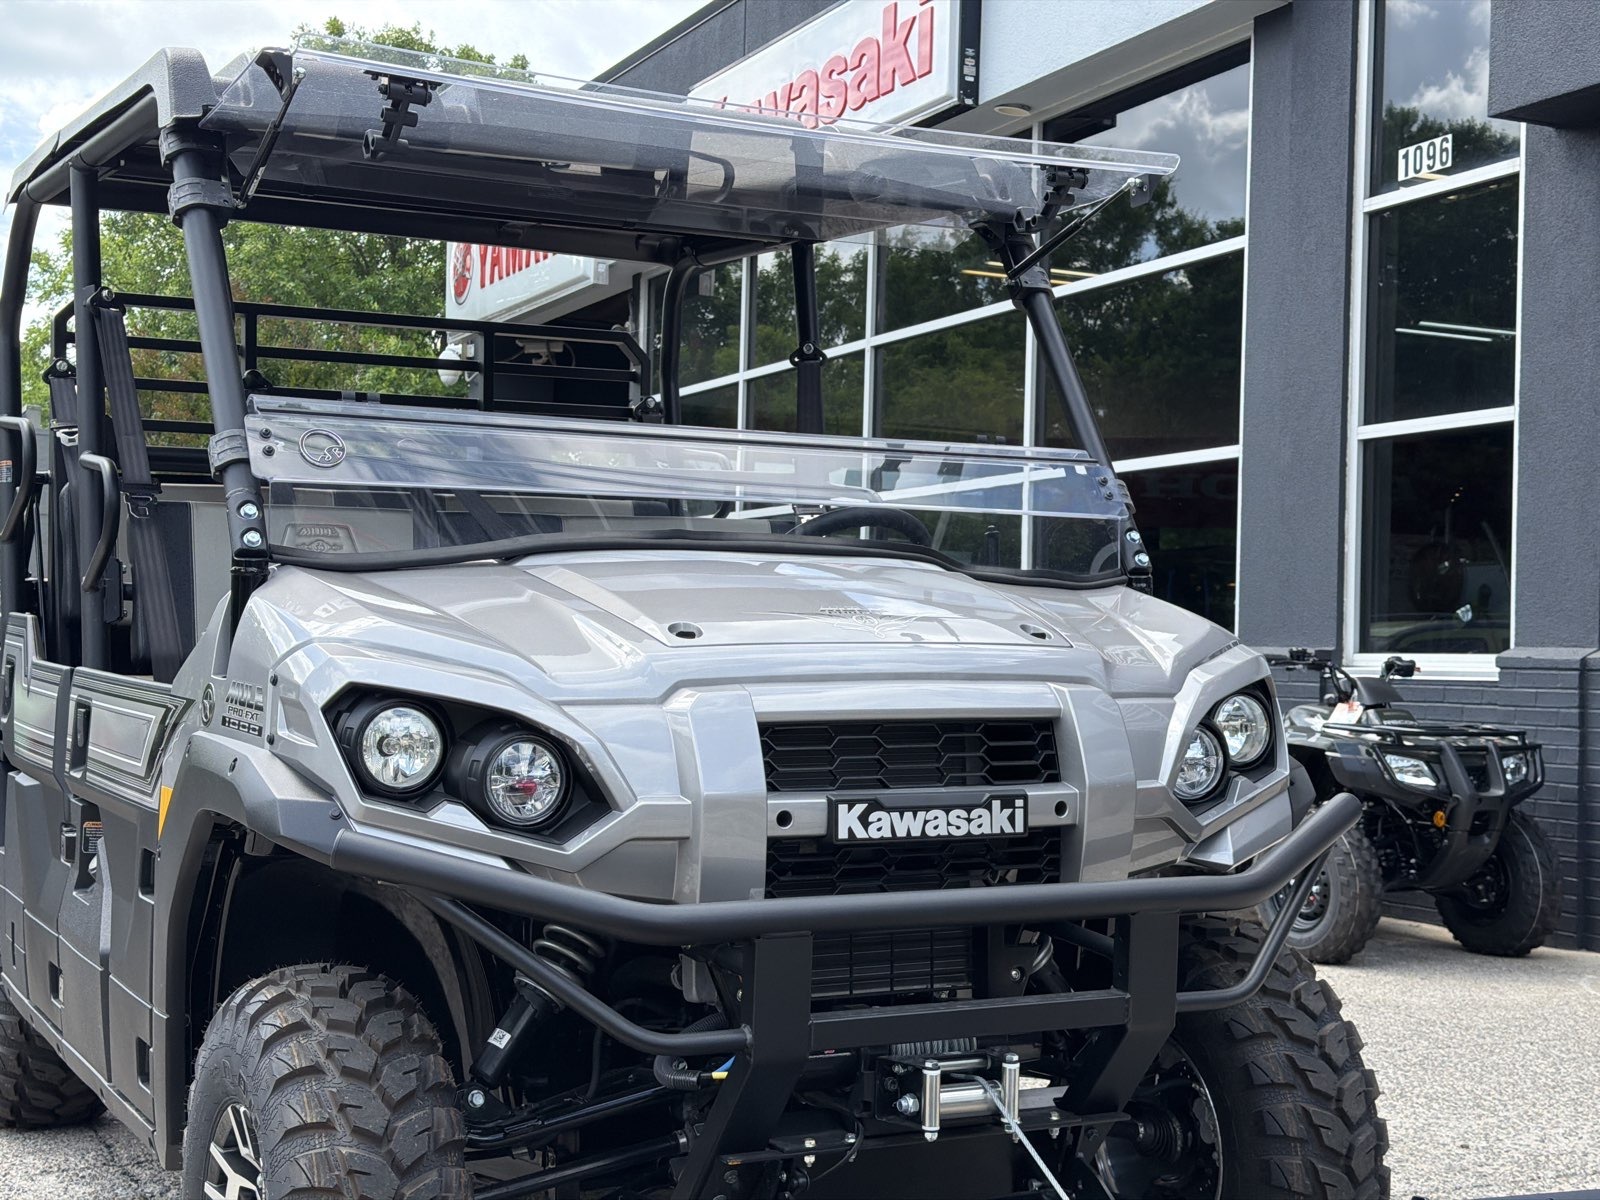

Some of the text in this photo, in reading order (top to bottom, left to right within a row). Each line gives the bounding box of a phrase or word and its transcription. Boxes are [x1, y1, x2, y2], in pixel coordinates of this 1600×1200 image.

[1402, 136, 1450, 178] 1096
[226, 681, 264, 712] MULE
[224, 717, 260, 735] 1000
[838, 800, 1024, 839] Kawasaki
